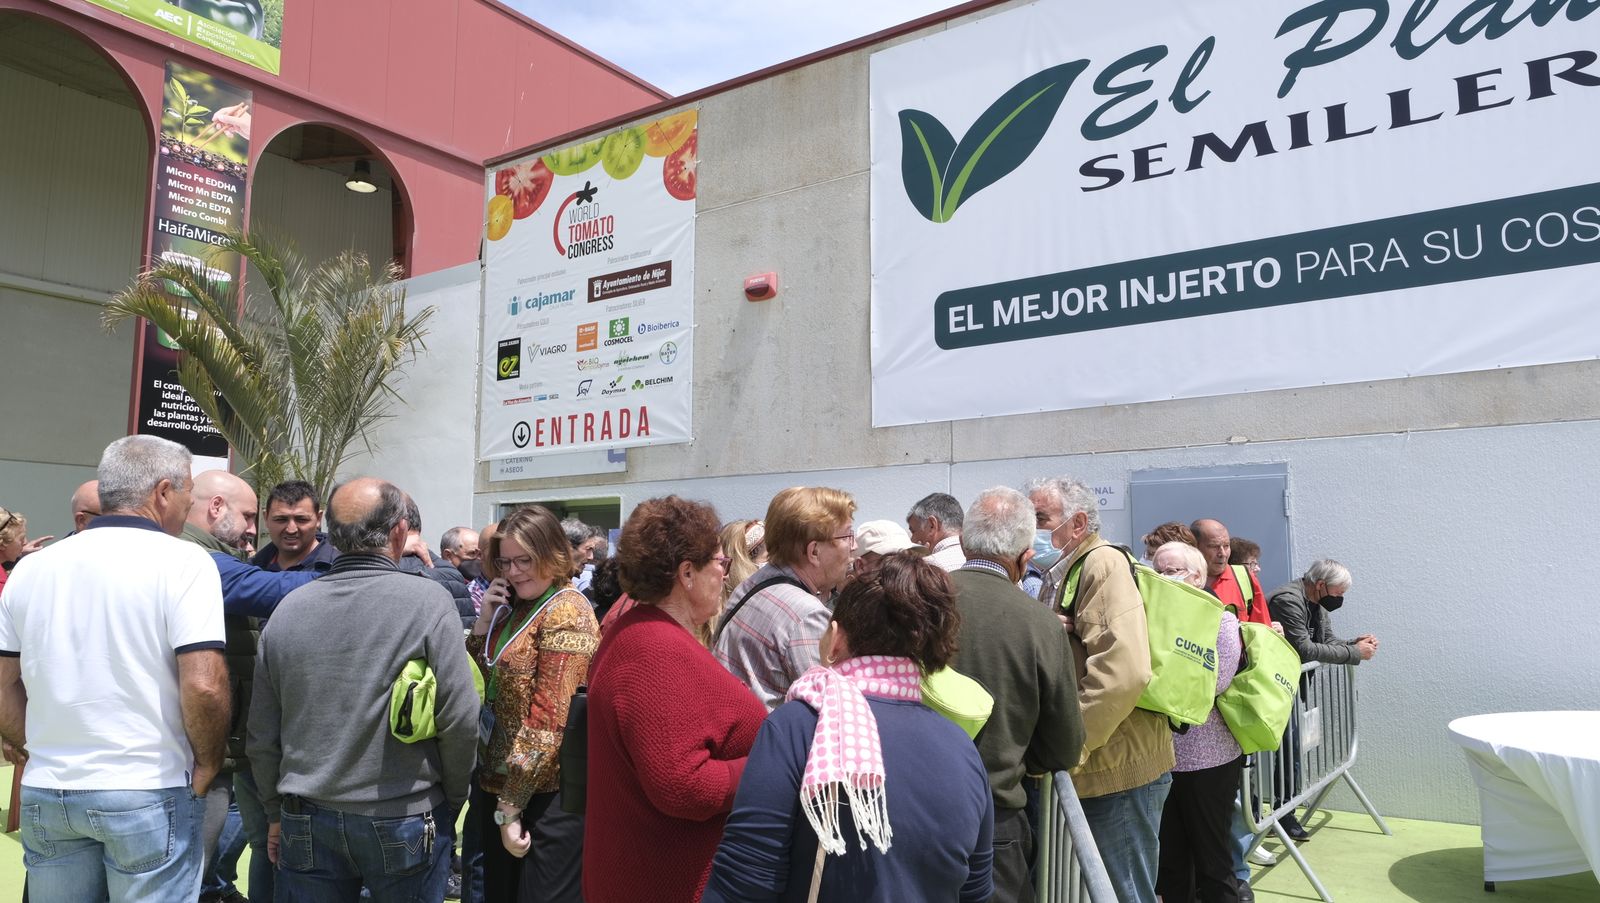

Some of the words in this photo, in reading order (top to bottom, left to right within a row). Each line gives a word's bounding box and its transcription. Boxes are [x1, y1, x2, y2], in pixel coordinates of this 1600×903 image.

[155, 8, 184, 26] AEC
[196, 26, 235, 45] Expositora
[1080, 35, 1216, 141] El
[1079, 50, 1600, 192] SEMILLER
[166, 166, 192, 180] Micro
[193, 174, 204, 184] Fe
[205, 177, 237, 193] EDDHA
[168, 179, 194, 192] Micro
[195, 187, 210, 197] Mn
[211, 191, 234, 204] EDTA
[168, 191, 194, 204] Micro
[195, 199, 207, 209] Zn
[208, 203, 232, 215] EDTA
[171, 205, 197, 218] Micro
[199, 212, 227, 226] Combi
[568, 203, 600, 224] WORLD
[568, 215, 614, 243] TOMATO
[568, 235, 614, 260] CONGRESS
[948, 304, 984, 334] EL
[992, 284, 1109, 327] MEJOR
[1119, 257, 1282, 309] INJERTO
[1295, 237, 1410, 284] PARA
[1422, 224, 1483, 264] SU
[1501, 206, 1600, 253] COS
[602, 274, 641, 291] Ayuntamiento
[643, 270, 650, 280] de
[525, 289, 576, 311] cajamar
[647, 320, 680, 333] Bioiberica
[539, 343, 567, 356] VIAGRO
[604, 336, 634, 347] COSMOCEL
[153, 380, 162, 388] El
[645, 376, 673, 386] BELCHIM
[162, 391, 183, 401] ideal
[602, 387, 626, 396] Daymsa
[153, 409, 166, 418] las
[167, 411, 199, 421] plantas
[161, 401, 200, 412] nutrición
[147, 418, 191, 430] desarrollo
[535, 406, 650, 447] ENTRADA
[505, 466, 523, 474] ASEOS
[1175, 637, 1204, 656] CUCN
